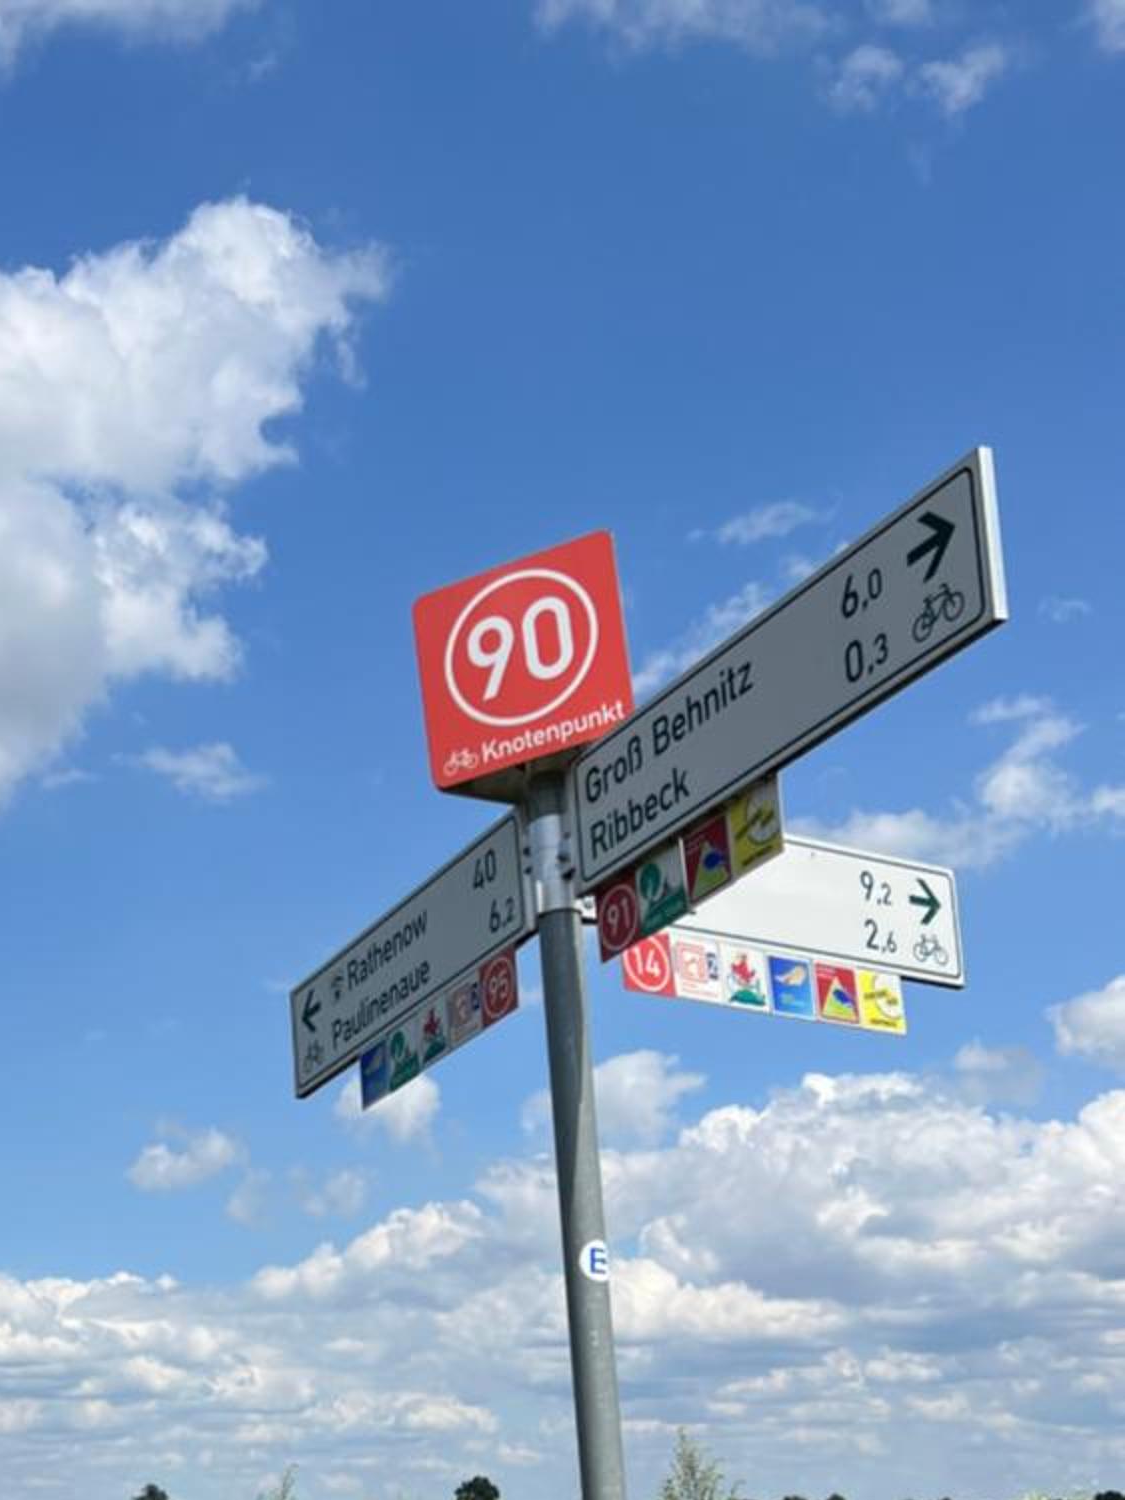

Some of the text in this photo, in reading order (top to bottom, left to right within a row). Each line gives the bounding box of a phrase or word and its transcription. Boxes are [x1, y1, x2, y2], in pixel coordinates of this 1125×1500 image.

[842, 568, 882, 619] 6,0
[467, 596, 574, 702] 90
[845, 632, 888, 683] 0,3
[481, 700, 626, 763] Knotenpunkt
[584, 661, 754, 803] Groß Behnitz
[589, 767, 690, 860] Ribbeck
[473, 847, 496, 891] 40
[860, 870, 893, 907] 9,2
[607, 896, 631, 937] 91
[864, 918, 898, 954] 2,6
[347, 908, 428, 991] Rathenow
[634, 945, 661, 977] 14
[331, 959, 431, 1050] Paulinenaue
[590, 1247, 606, 1274] E
